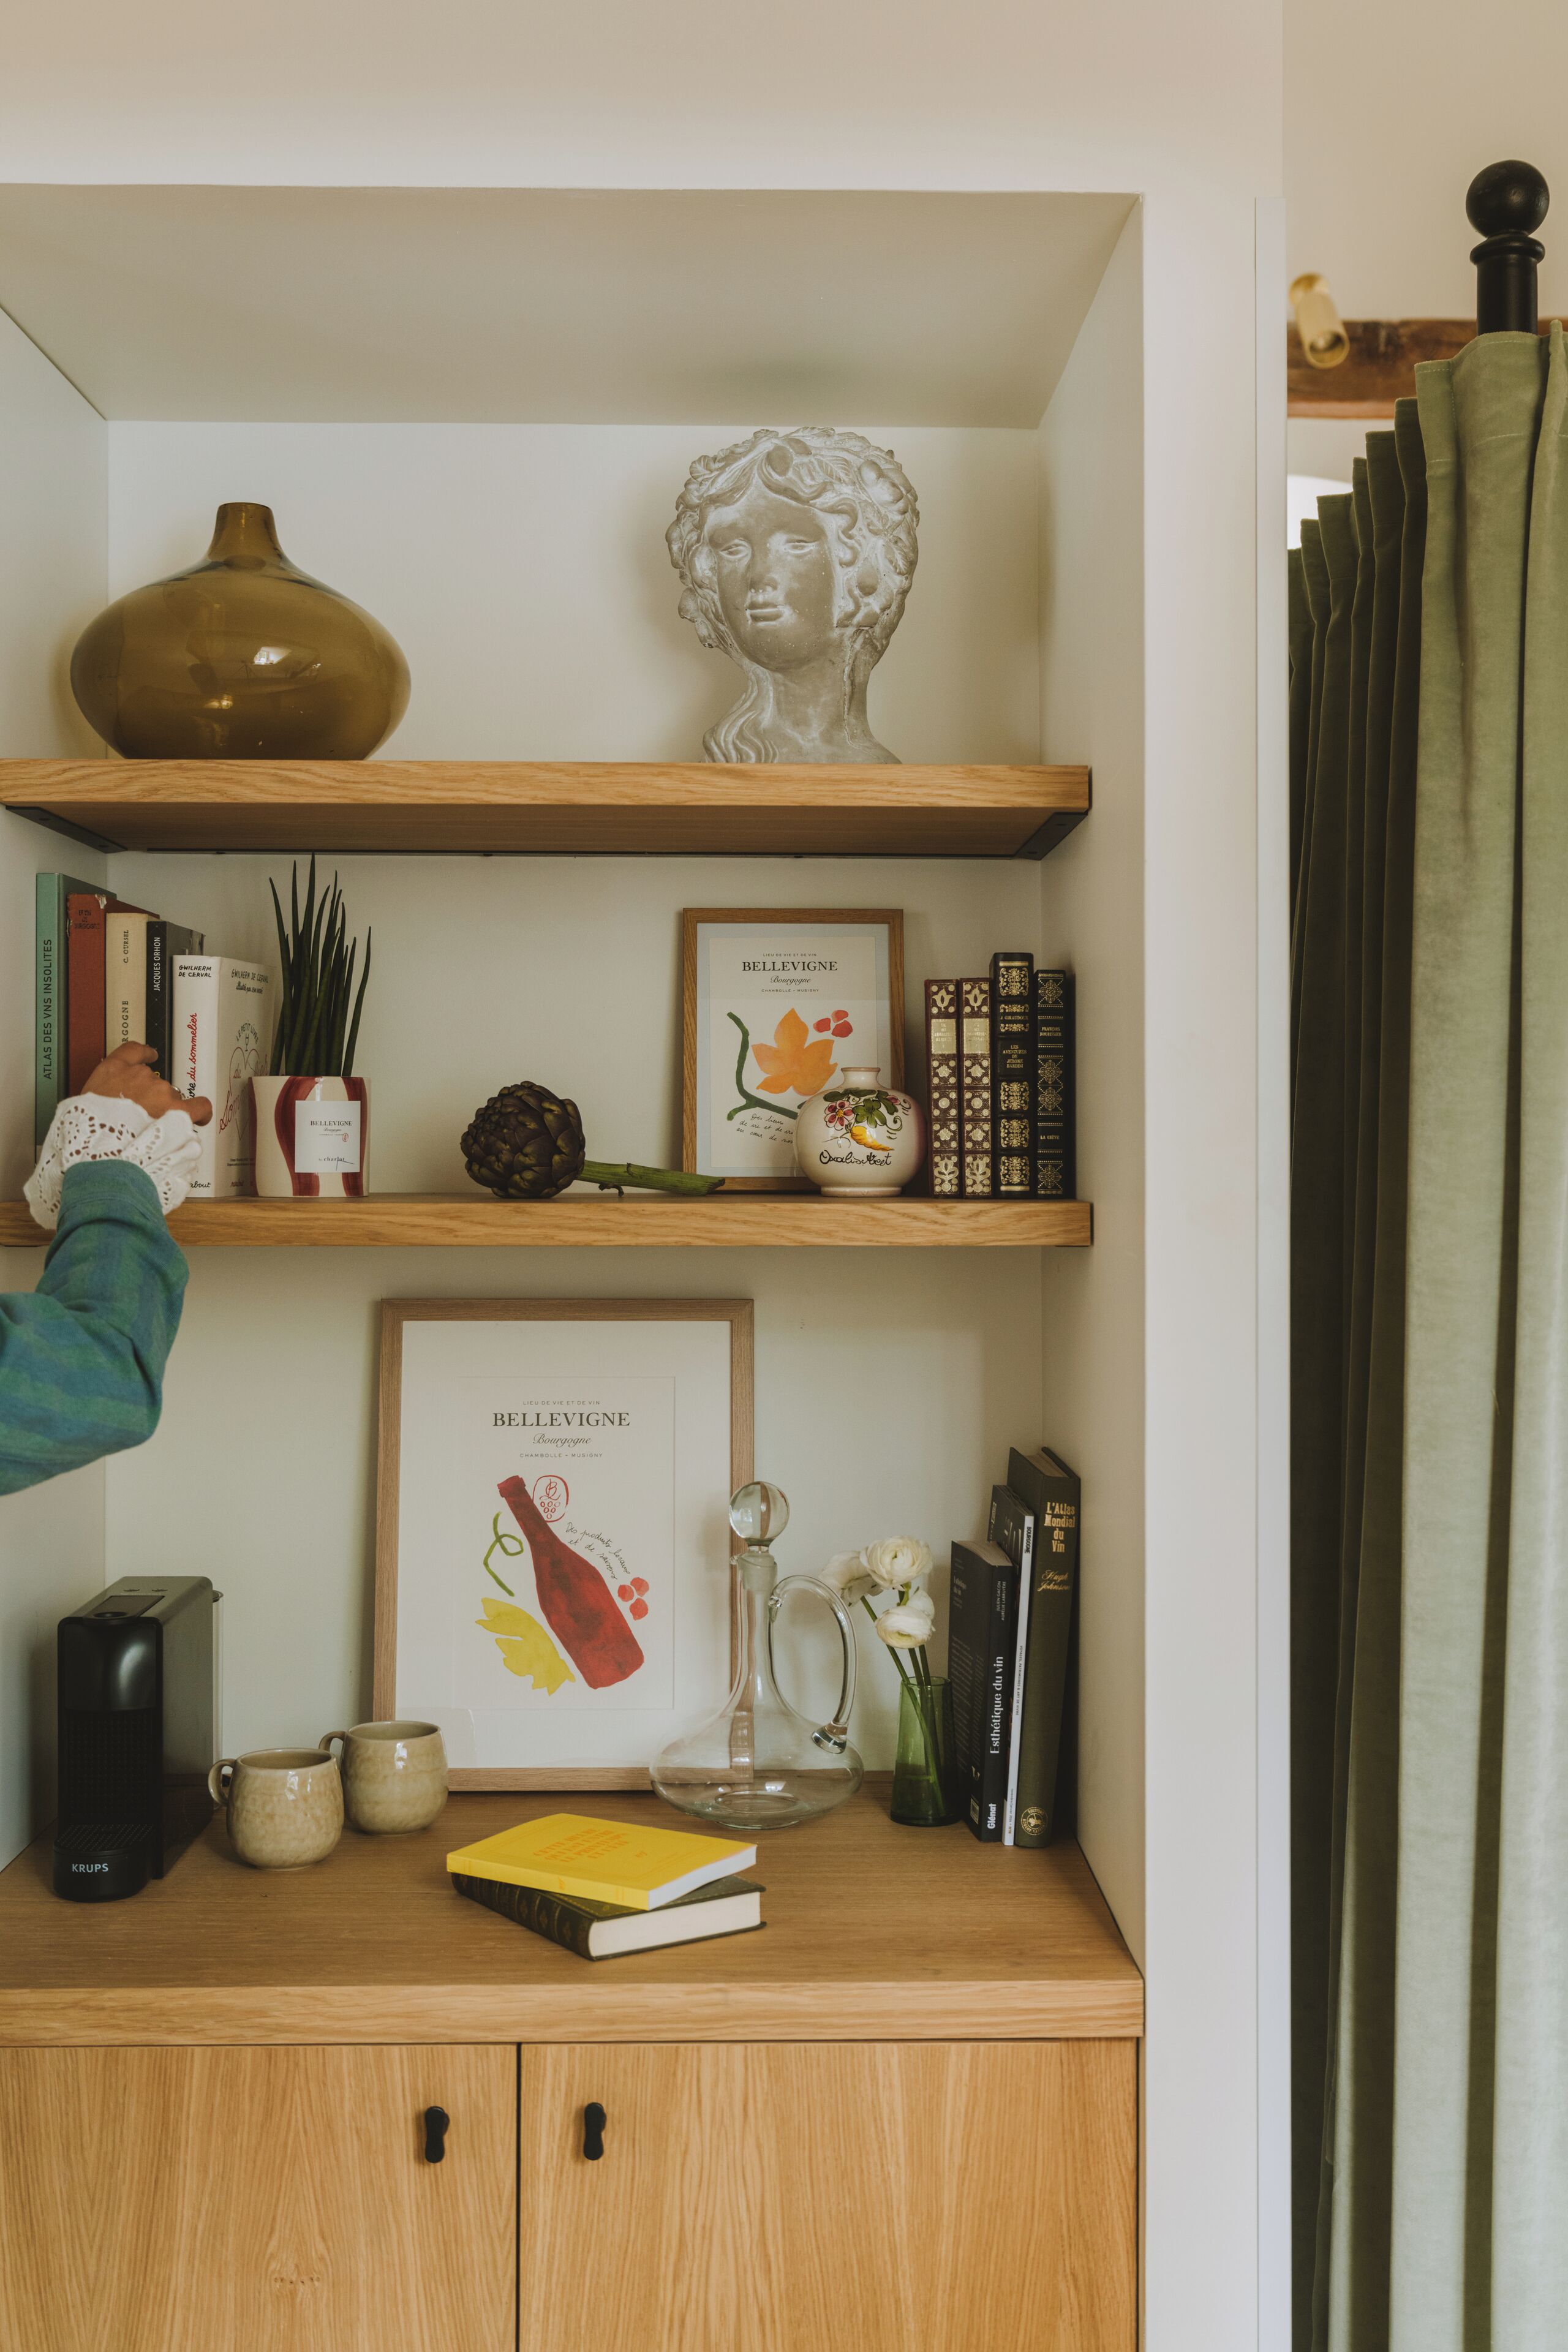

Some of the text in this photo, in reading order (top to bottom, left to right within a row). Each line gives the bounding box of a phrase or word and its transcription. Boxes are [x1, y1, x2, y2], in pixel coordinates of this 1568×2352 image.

[742, 961, 838, 971] BELLEVIGNE
[231, 968, 269, 984] GWILHERM DE CERVAL
[770, 975, 812, 986] Bourgogne
[43, 1022, 52, 1043] DES
[187, 1012, 197, 1065] sommelier
[43, 1048, 52, 1080] ATLAS
[186, 1066, 197, 1082] du
[492, 1412, 630, 1427] BELLEVIGNE
[532, 1433, 592, 1448] Bourgogne
[1046, 1501, 1076, 1515] L'Atlas
[1044, 1513, 1076, 1528] Mondial
[565, 1522, 577, 1533] Des
[580, 1529, 613, 1548] produits
[1054, 1528, 1065, 1540] du
[585, 1543, 595, 1553] de
[1052, 1540, 1065, 1553] Vin
[1042, 1569, 1069, 1582] Hugh
[1037, 1581, 1070, 1592] Johnson
[990, 1656, 1004, 1754] Esthétique du vin
[987, 1803, 997, 1830] Glénat
[72, 1863, 109, 1872] KRUPS
